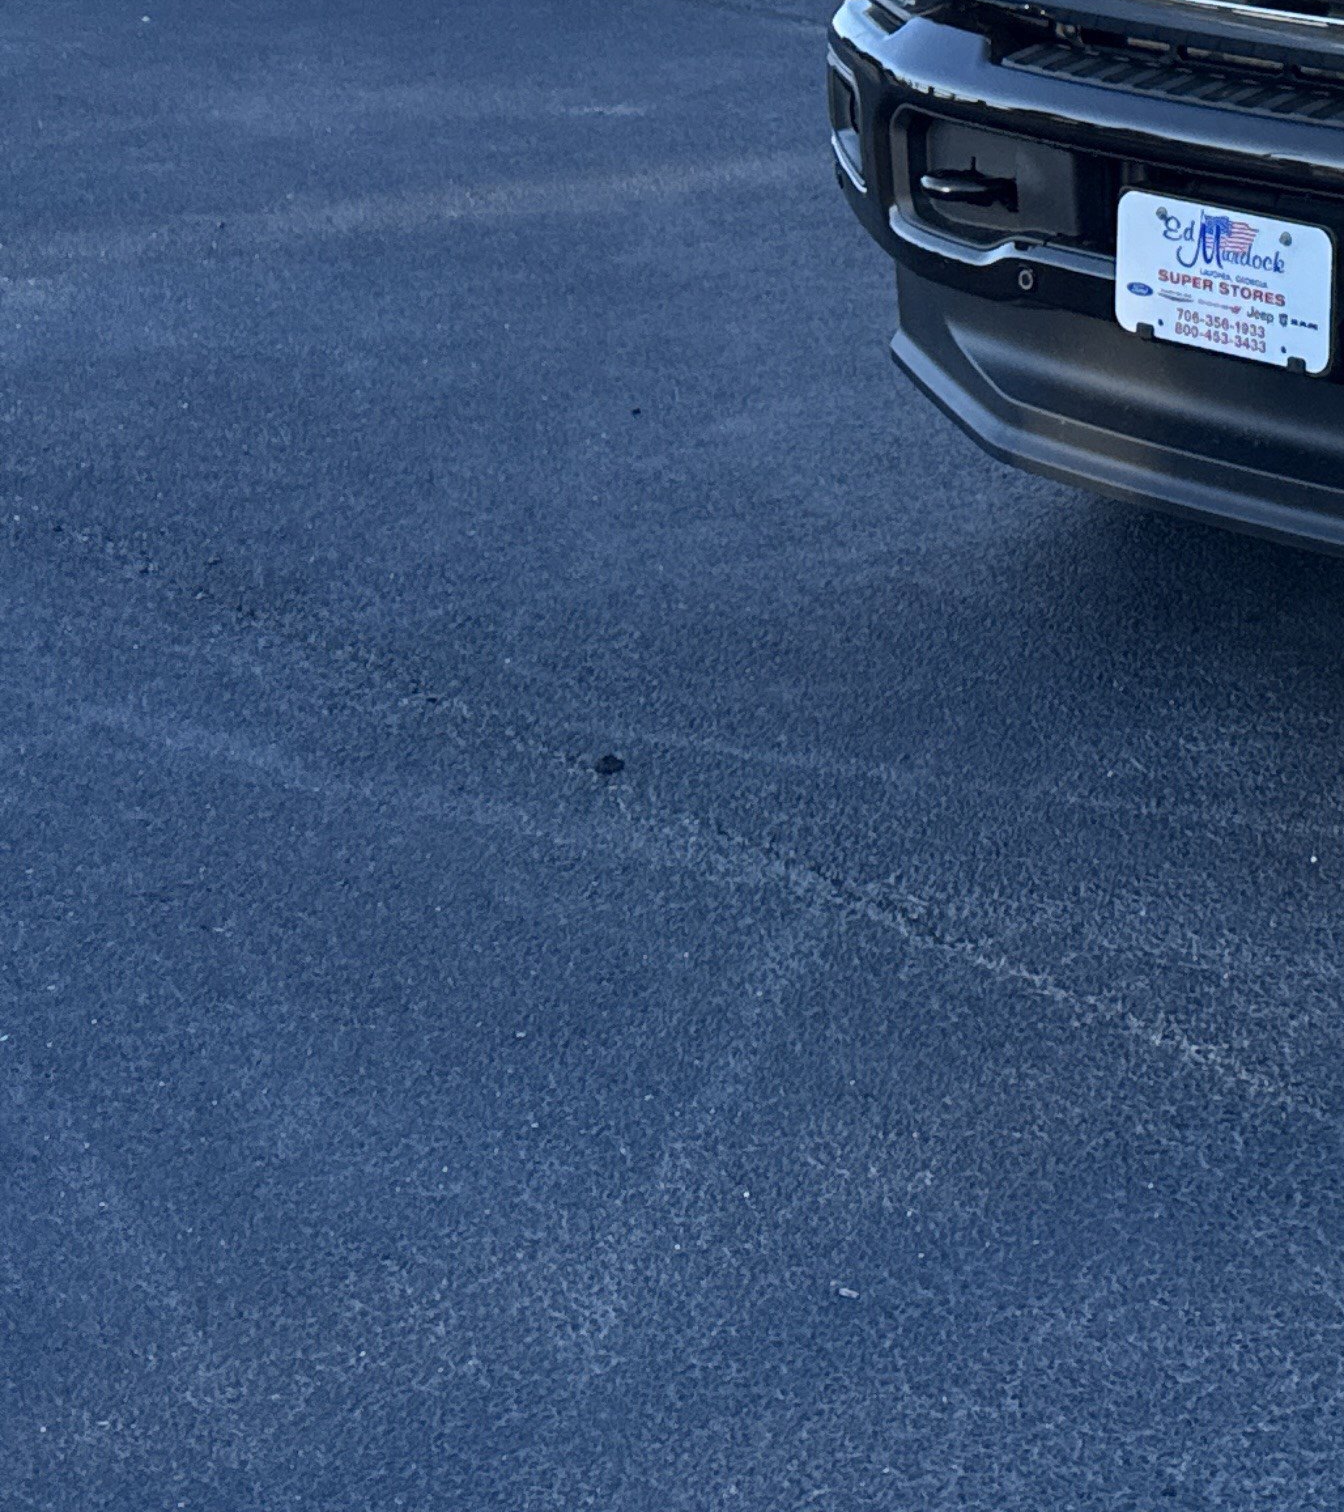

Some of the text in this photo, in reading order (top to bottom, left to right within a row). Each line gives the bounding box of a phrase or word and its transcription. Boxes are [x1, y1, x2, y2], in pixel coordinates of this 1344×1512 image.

[1162, 215, 1286, 274] Ed Murdock
[1157, 268, 1214, 292] SUPER
[1219, 281, 1286, 307] STORES
[1246, 306, 1275, 325] Jeep
